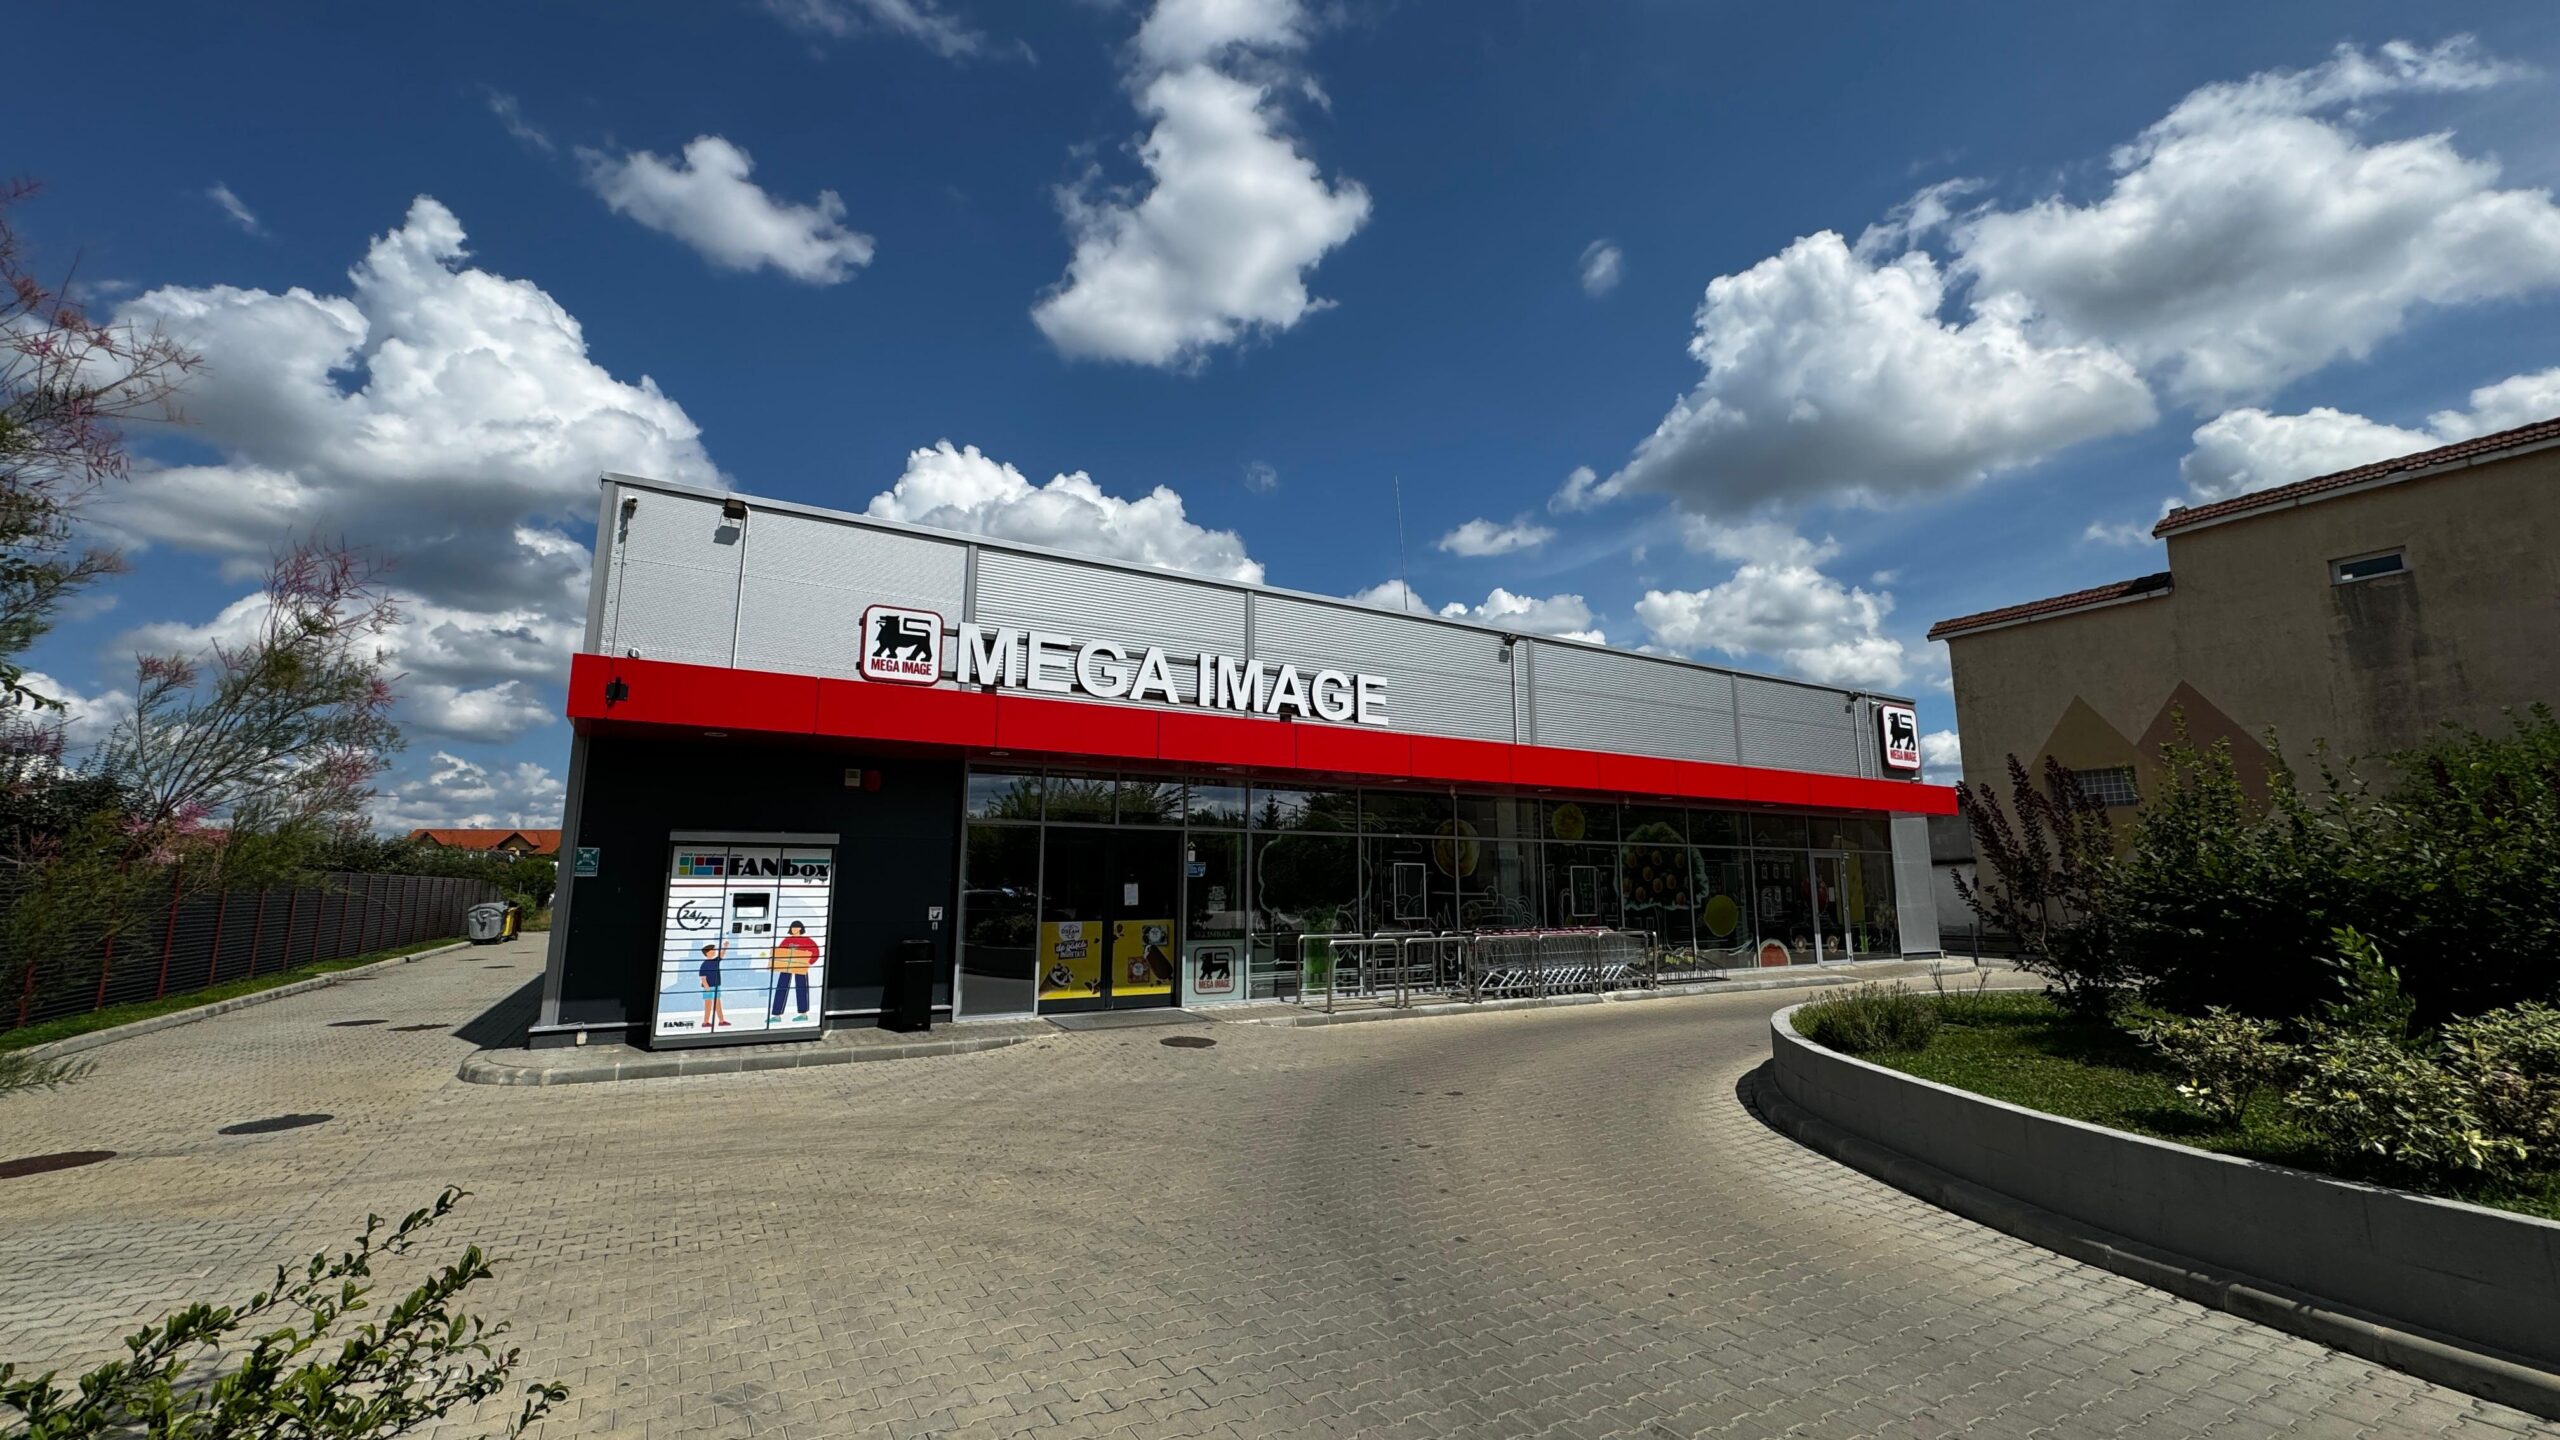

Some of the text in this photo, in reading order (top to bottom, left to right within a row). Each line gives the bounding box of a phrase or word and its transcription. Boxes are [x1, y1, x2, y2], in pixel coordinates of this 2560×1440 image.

[871, 658, 933, 676] MEGA IMAGE
[957, 622, 1389, 726] MEGA IMAGE
[1889, 749, 1918, 762] MEGA IMAGE
[728, 857, 830, 876] FANbox
[1199, 980, 1230, 989] MEGA IMAGE
